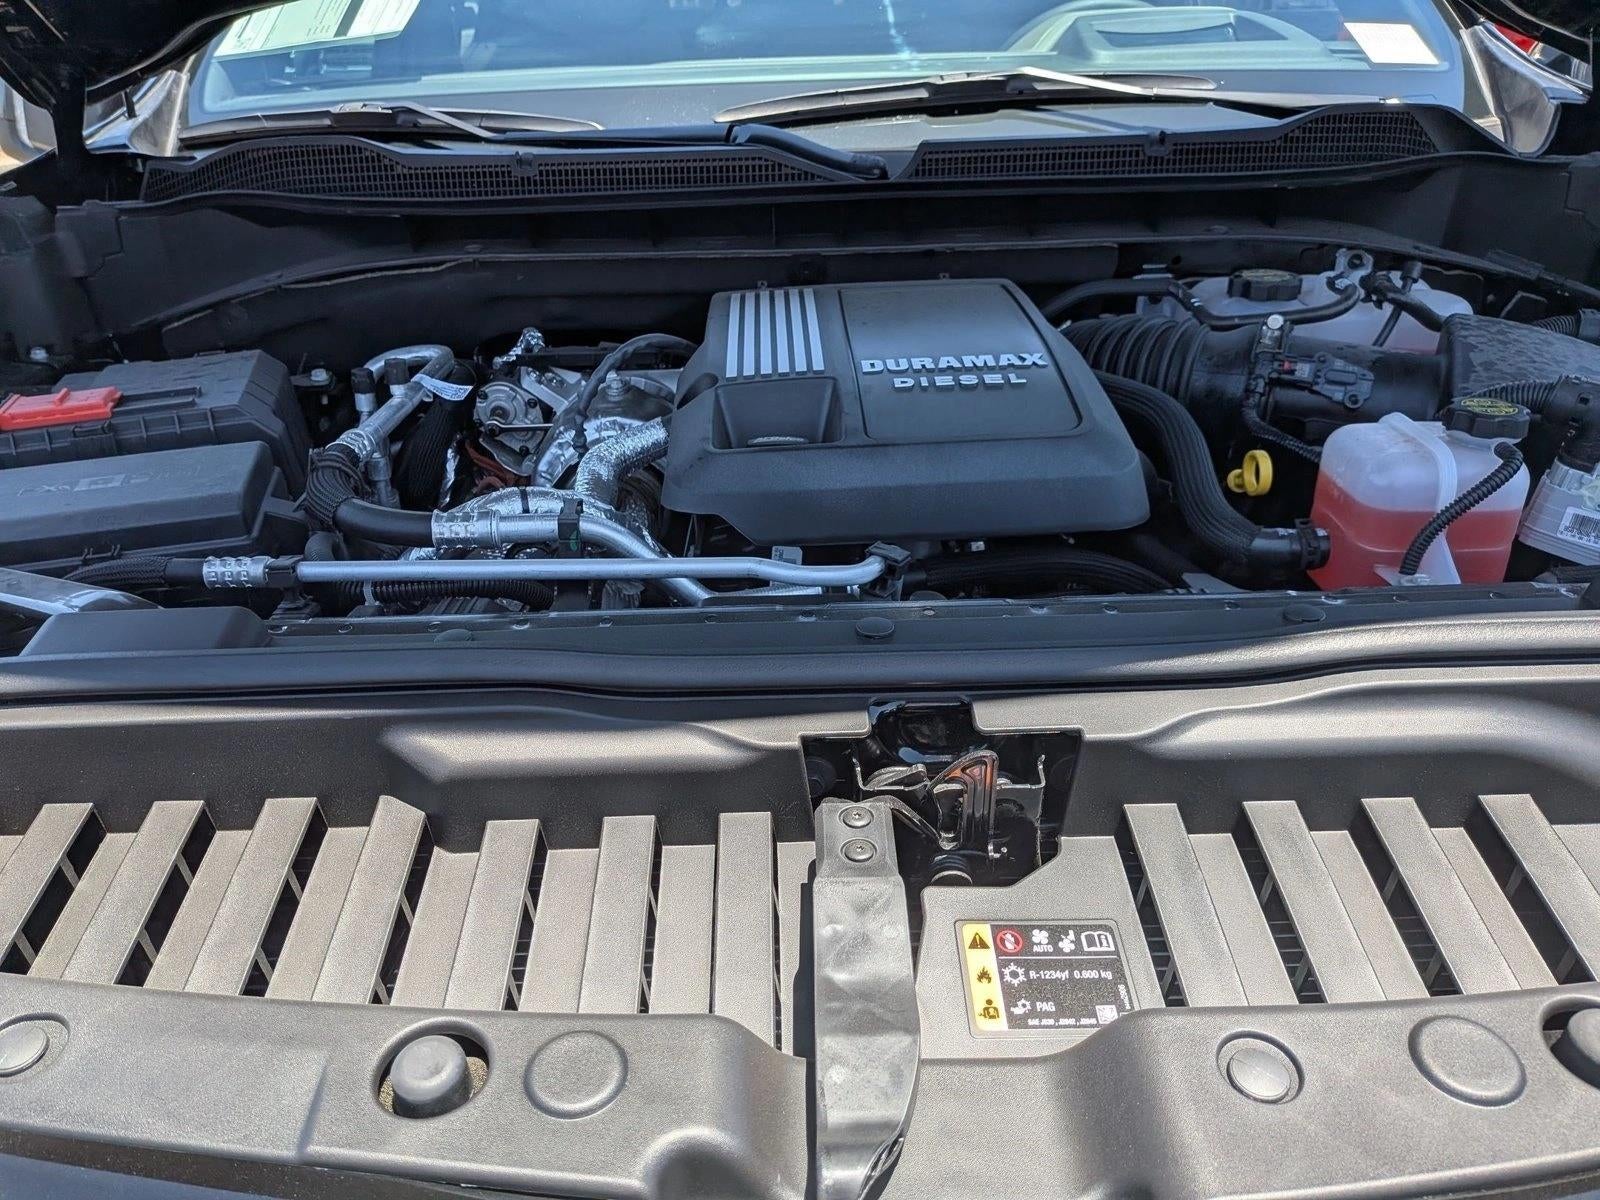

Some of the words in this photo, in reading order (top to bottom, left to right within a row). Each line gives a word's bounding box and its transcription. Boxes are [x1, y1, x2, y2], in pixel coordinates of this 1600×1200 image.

[860, 352, 1049, 374] DURAMAX
[893, 373, 1027, 391] DIESEL
[1033, 944, 1054, 953] AUTO
[1029, 970, 1069, 980] R-1234yf
[1100, 970, 1113, 980] kg
[1036, 1001, 1056, 1012] PAG
